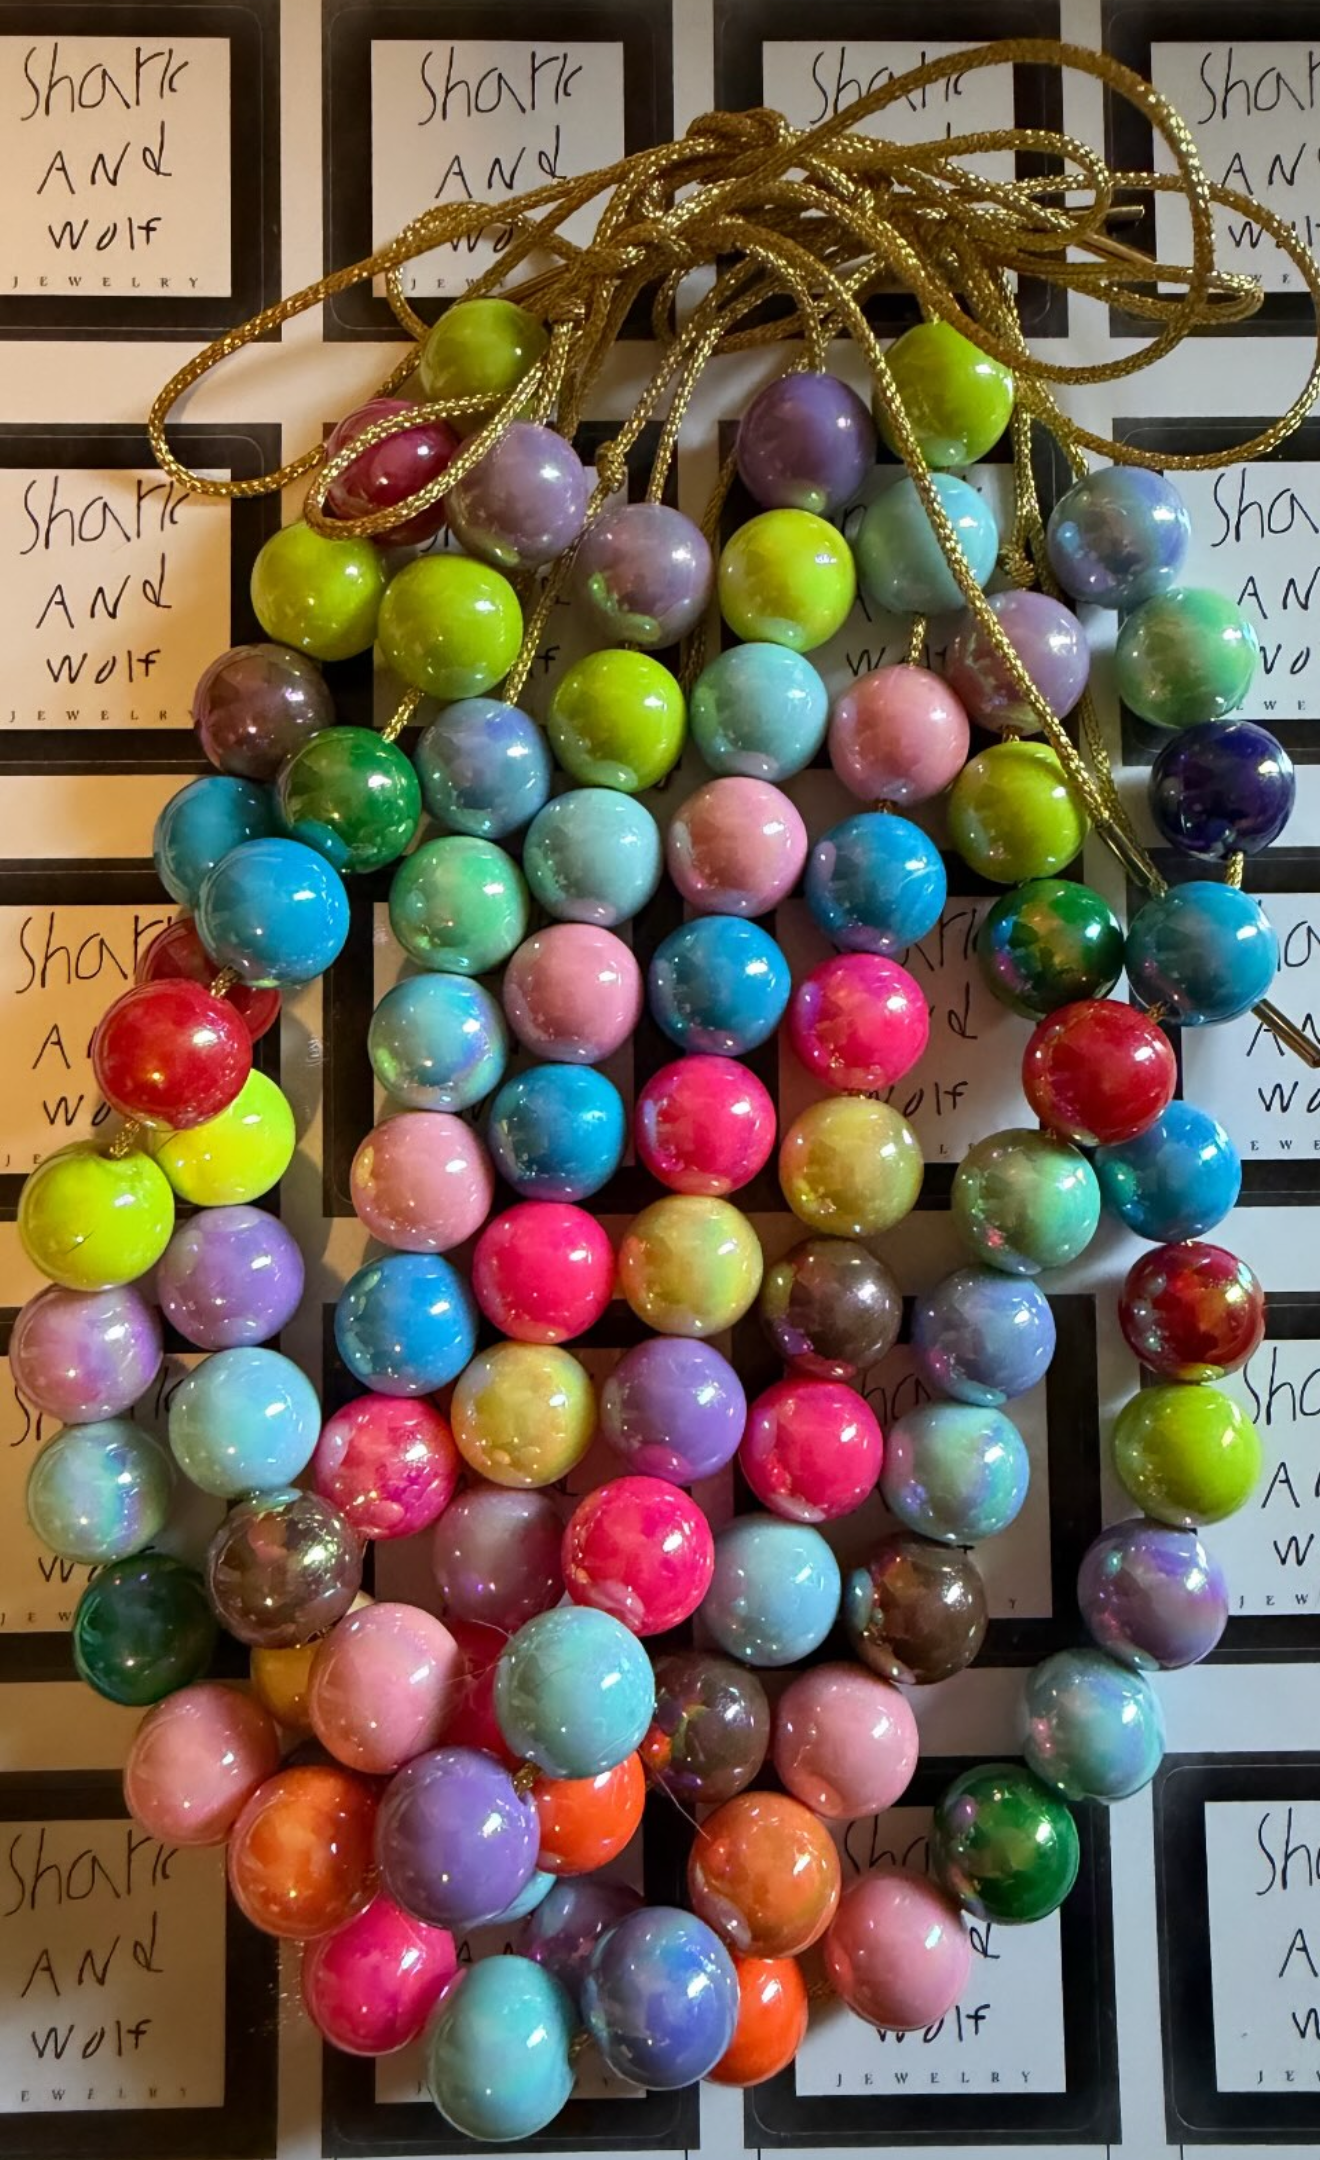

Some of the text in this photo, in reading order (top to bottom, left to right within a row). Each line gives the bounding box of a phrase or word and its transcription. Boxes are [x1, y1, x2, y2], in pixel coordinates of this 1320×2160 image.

[20, 42, 189, 122] Shark
[417, 46, 583, 126] Shark
[1198, 47, 1320, 124] Shar
[12, 275, 200, 289] JEWELRY
[20, 475, 190, 555] Shark
[15, 911, 172, 994] Shar
[836, 2071, 1032, 2087] JEWELRY
